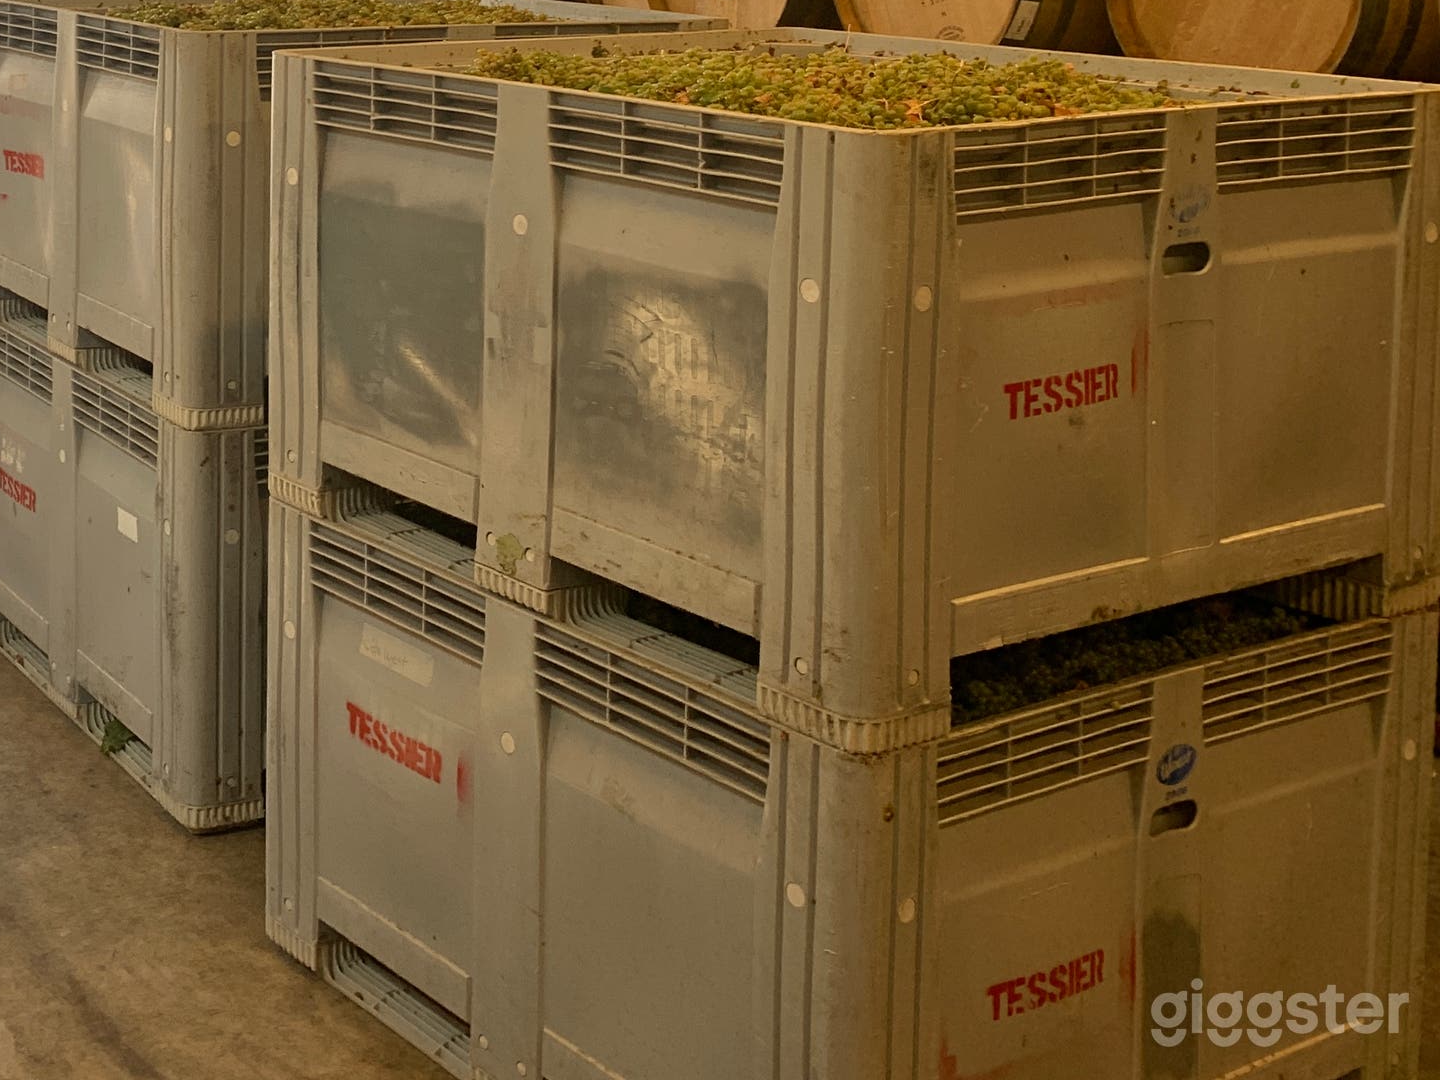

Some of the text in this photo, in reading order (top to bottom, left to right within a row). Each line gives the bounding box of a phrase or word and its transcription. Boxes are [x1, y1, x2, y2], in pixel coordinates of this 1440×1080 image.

[2, 149, 46, 180] TESSIER
[1003, 363, 1119, 421] TESSIER
[346, 701, 442, 784] TESSIER
[986, 949, 1105, 1022] TESSIER
